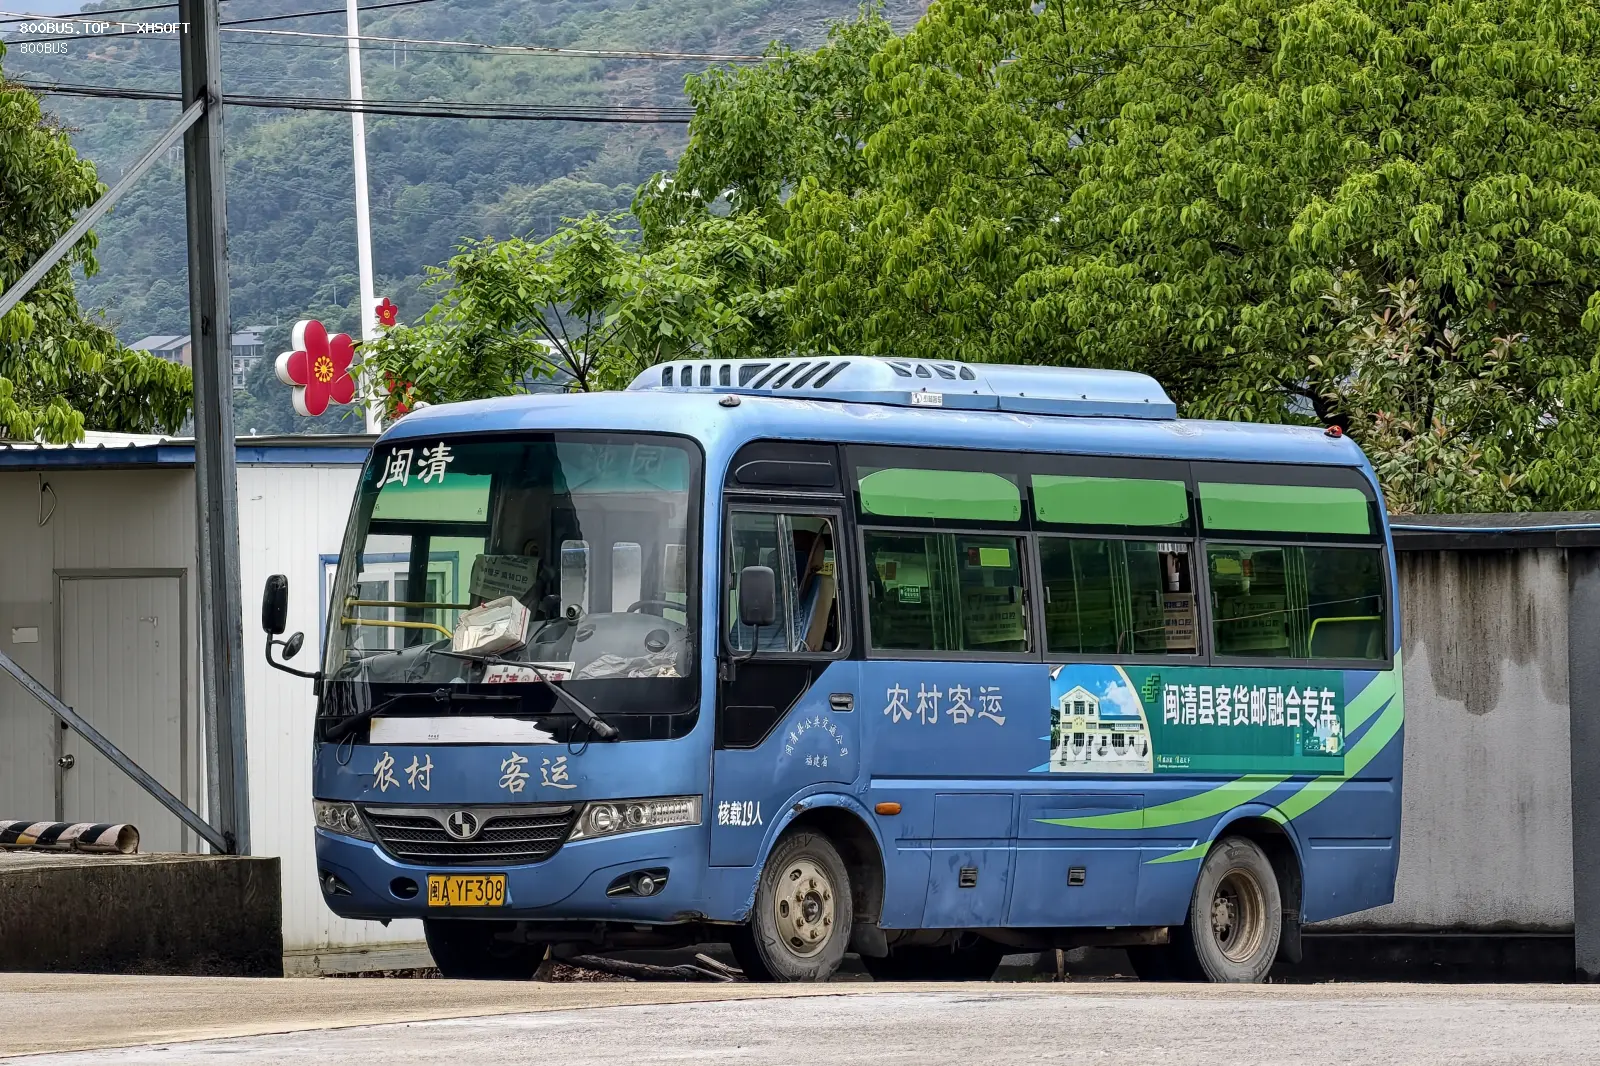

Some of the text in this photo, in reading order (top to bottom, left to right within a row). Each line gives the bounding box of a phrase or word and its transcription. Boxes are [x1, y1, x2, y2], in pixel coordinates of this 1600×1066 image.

[376, 441, 455, 489] 闽清
[883, 682, 1006, 726] 农村客运
[1163, 683, 1337, 731] 闽清县客货邮融合专车
[372, 751, 578, 794] 农村 客运
[804, 753, 829, 768] 福建省
[717, 800, 763, 827] 核载19人
[430, 879, 503, 902] 闽A·YF308
